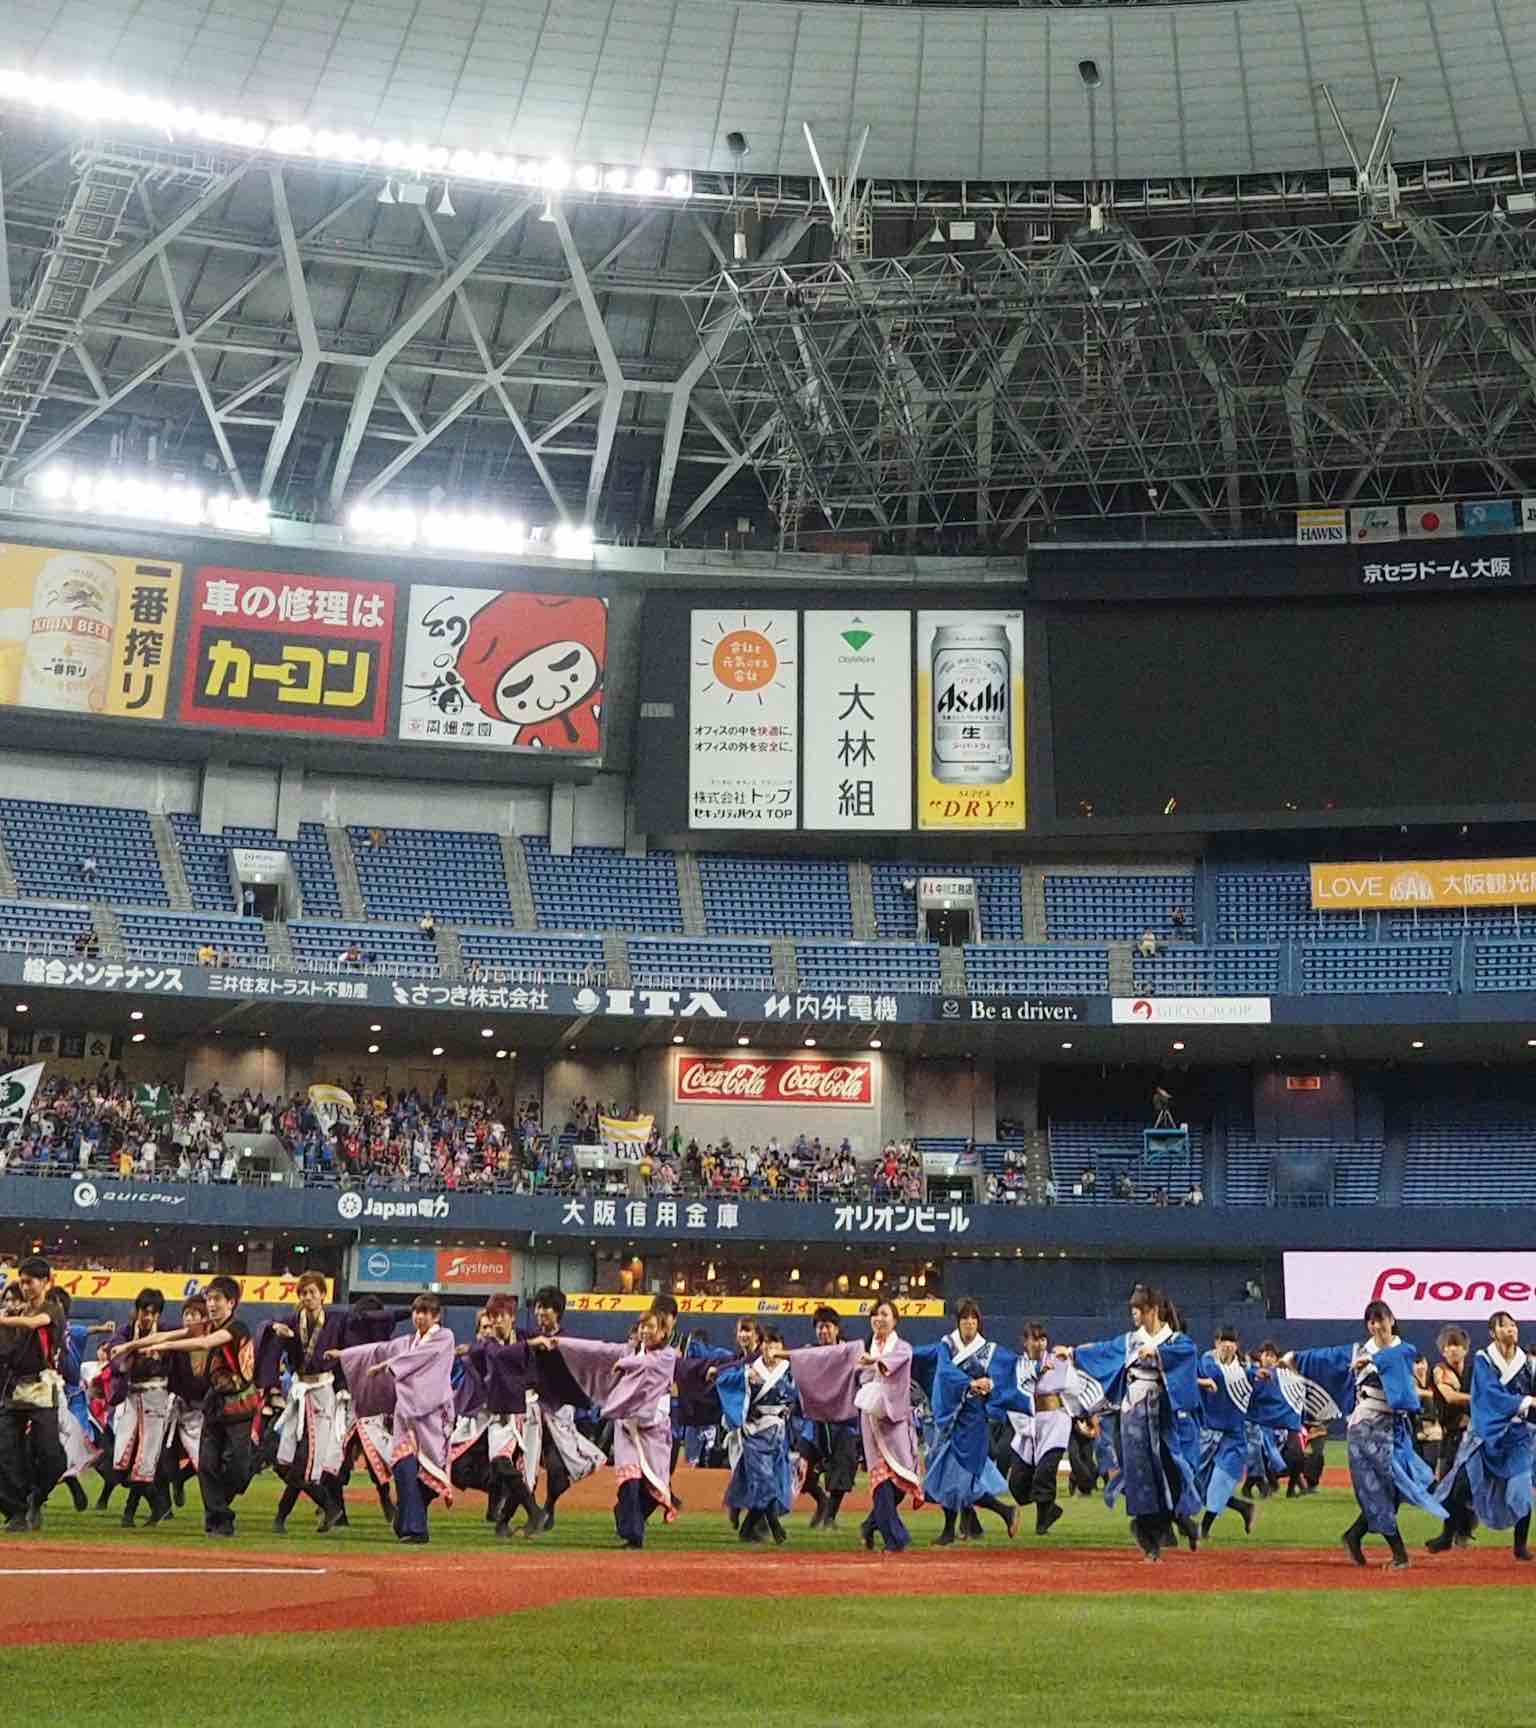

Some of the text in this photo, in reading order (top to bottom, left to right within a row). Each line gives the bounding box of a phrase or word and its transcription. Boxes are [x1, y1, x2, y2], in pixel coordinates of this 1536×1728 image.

[1300, 527, 1343, 542] HAWKS
[201, 578, 385, 629] 車の修理は
[32, 617, 111, 639] KIRIN BEER
[122, 564, 173, 710] 一番搾り
[43, 663, 88, 678] 一番搾り
[205, 638, 372, 708] カーコン
[937, 682, 1006, 713] Asahi
[961, 725, 982, 740] 生
[837, 682, 876, 817] 大林組
[694, 787, 793, 805] 株式会社 トップ
[767, 808, 793, 819] TOP
[1317, 875, 1383, 899] LOVE
[22, 956, 185, 993] 総合メンテナンス
[207, 974, 369, 1001] 三井住友トラスト不動産
[410, 982, 550, 1011] さつき株式会社
[795, 994, 898, 1022] 内外電機
[970, 999, 1078, 1021] Be a driver.
[681, 1062, 869, 1098] Coca-Cola Coca-Cola
[102, 1191, 187, 1205] QUICPay
[362, 1193, 450, 1221] Japan電力
[562, 1198, 740, 1229] 大阪信用金庫
[834, 1202, 971, 1233] オリオンビール
[577, 1296, 622, 1311] ガイア
[679, 1298, 725, 1313] ガイア
